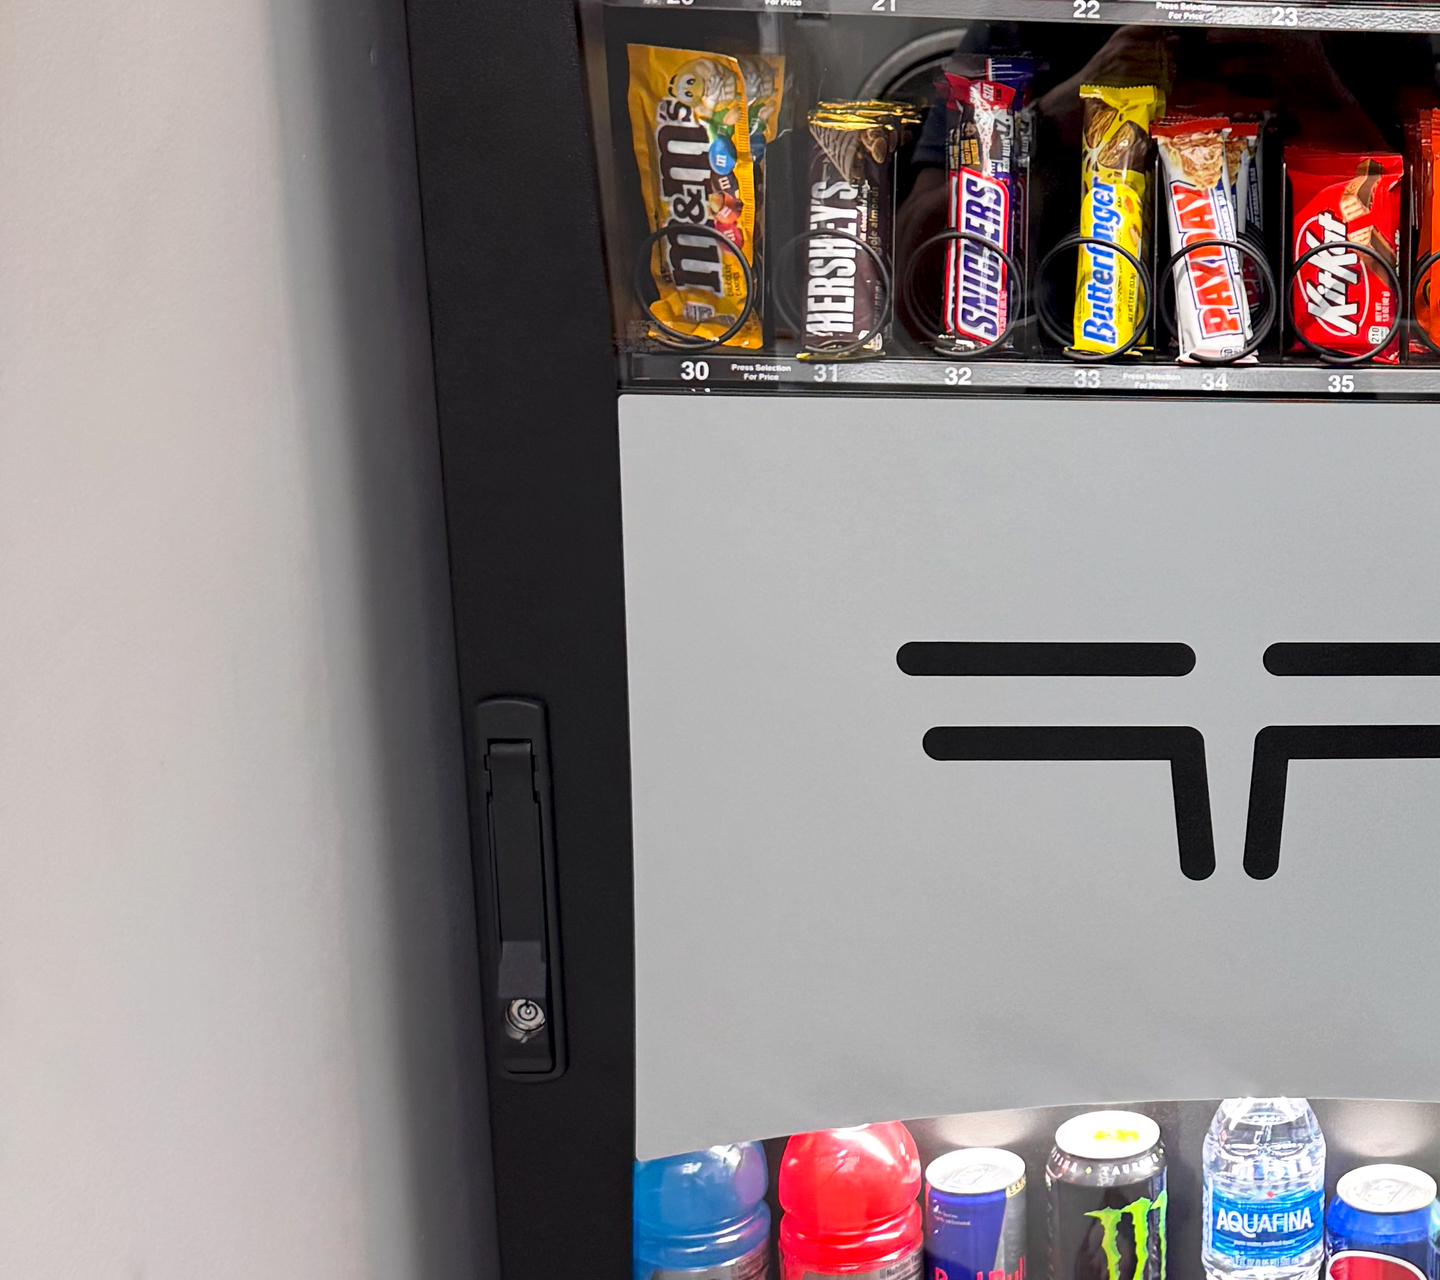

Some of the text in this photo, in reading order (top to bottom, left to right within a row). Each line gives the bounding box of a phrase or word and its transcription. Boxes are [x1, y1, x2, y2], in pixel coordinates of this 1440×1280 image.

[1073, 0, 1100, 19] 22
[1271, 7, 1298, 27] 23
[959, 177, 1002, 339] SNICKERS
[1082, 174, 1123, 346] Butterfnger
[1177, 179, 1242, 337] PAYDAY
[1371, 327, 1380, 344] 210
[680, 361, 710, 382] 30
[731, 363, 792, 372] Press Selection
[743, 372, 780, 382] For Price
[813, 363, 839, 382] 31
[944, 367, 972, 386] 32
[1074, 369, 1101, 389] 33
[1201, 372, 1229, 392] 34
[1327, 375, 1355, 394] 35
[1215, 1206, 1315, 1239] AQUAFINA
